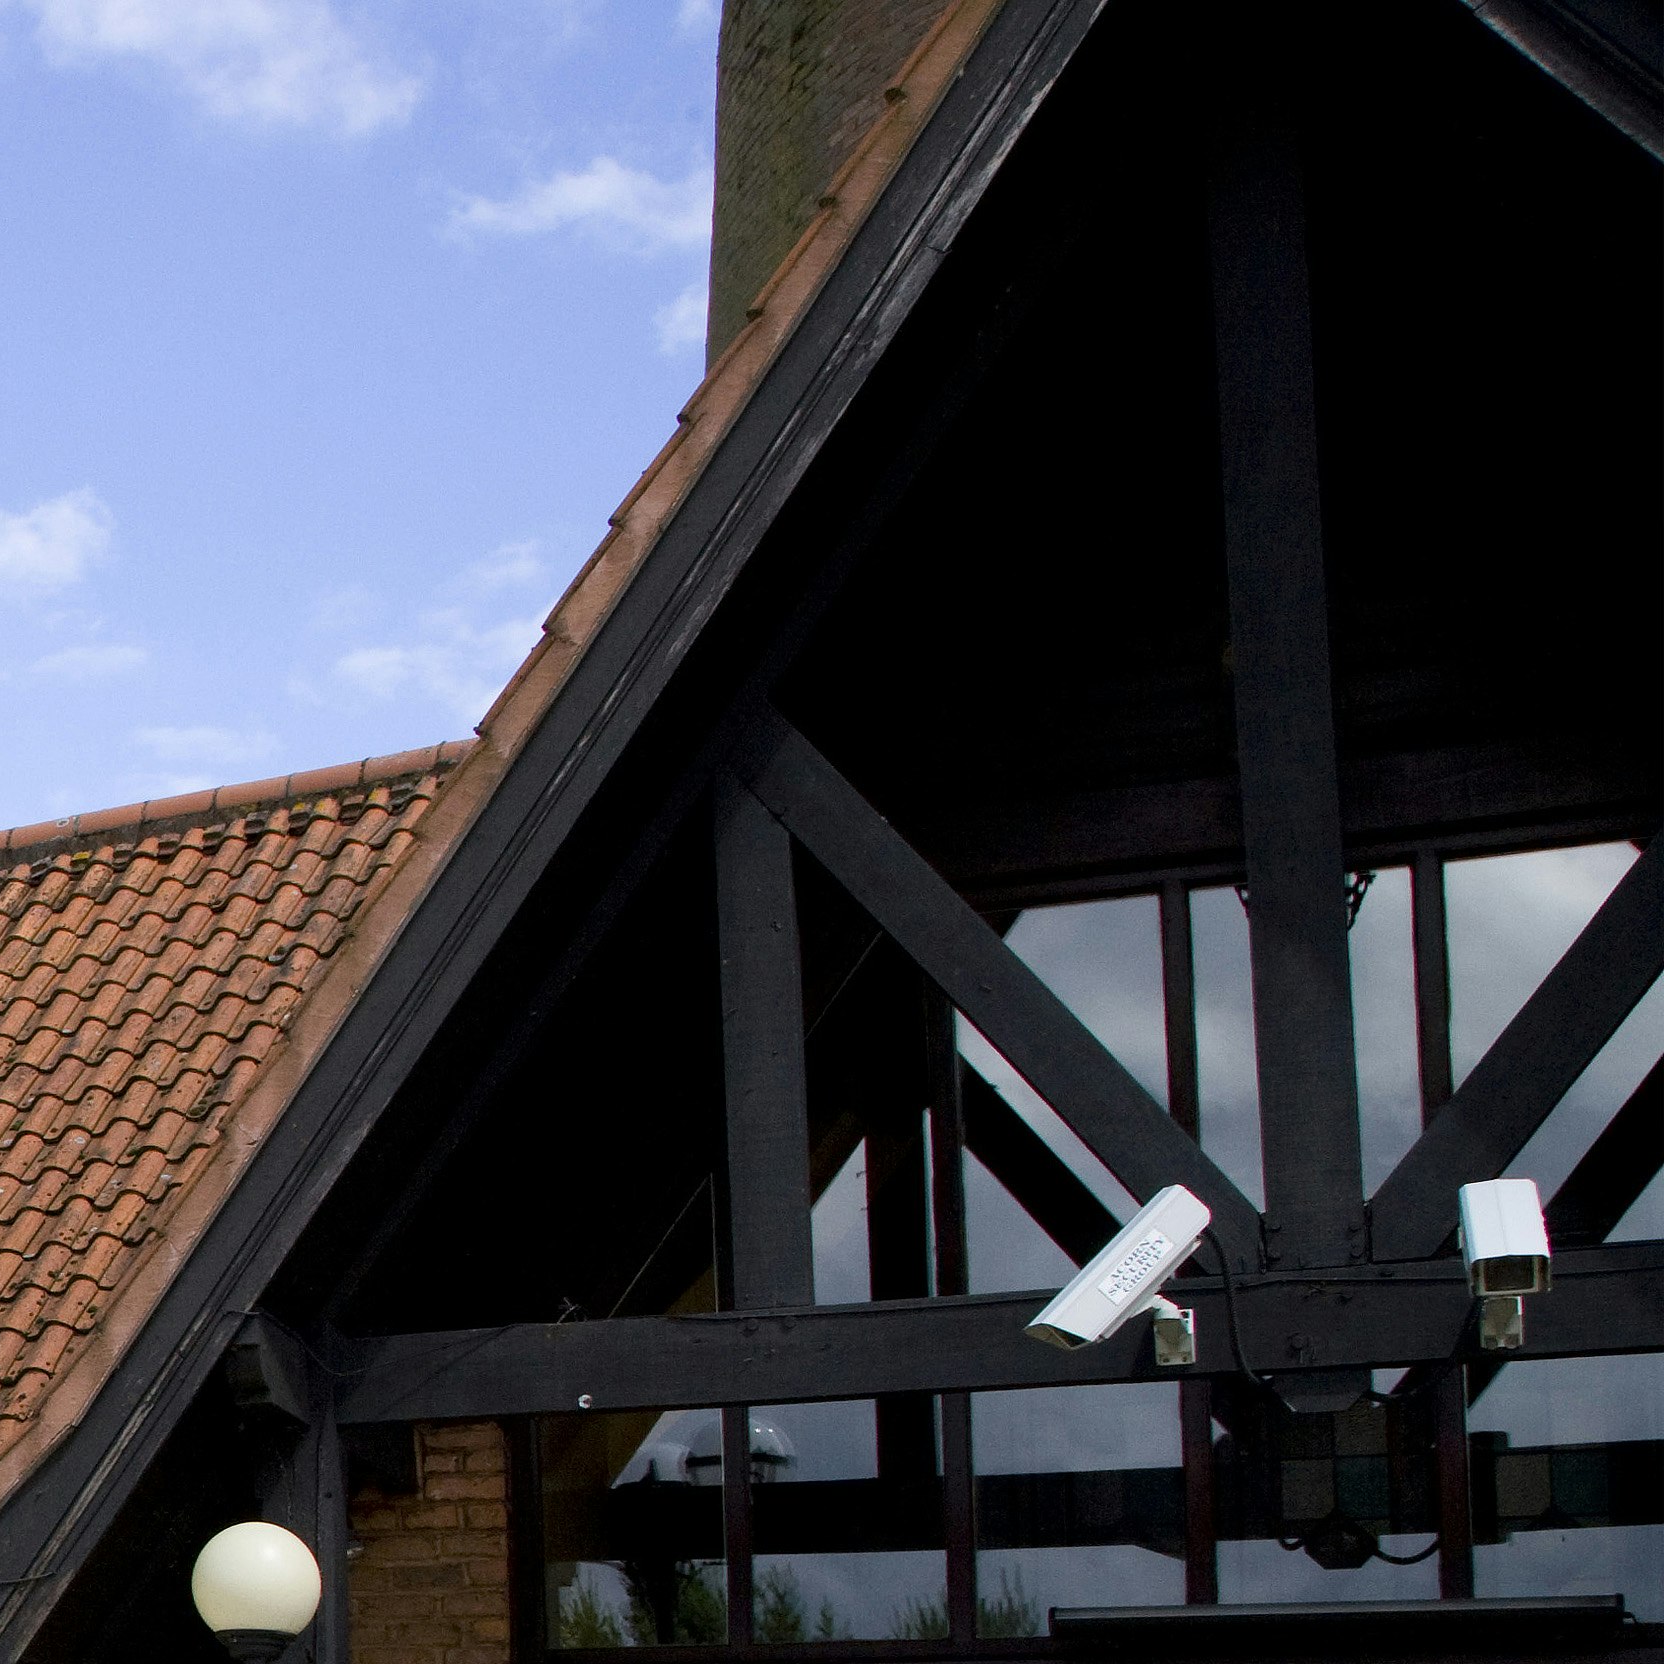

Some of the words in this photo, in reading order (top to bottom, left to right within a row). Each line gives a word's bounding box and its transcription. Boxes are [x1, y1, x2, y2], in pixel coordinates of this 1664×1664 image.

[1108, 1237, 1164, 1296] SECURITY
[1110, 1241, 1150, 1281] ACORN
[1122, 1249, 1161, 1293] GROUP
